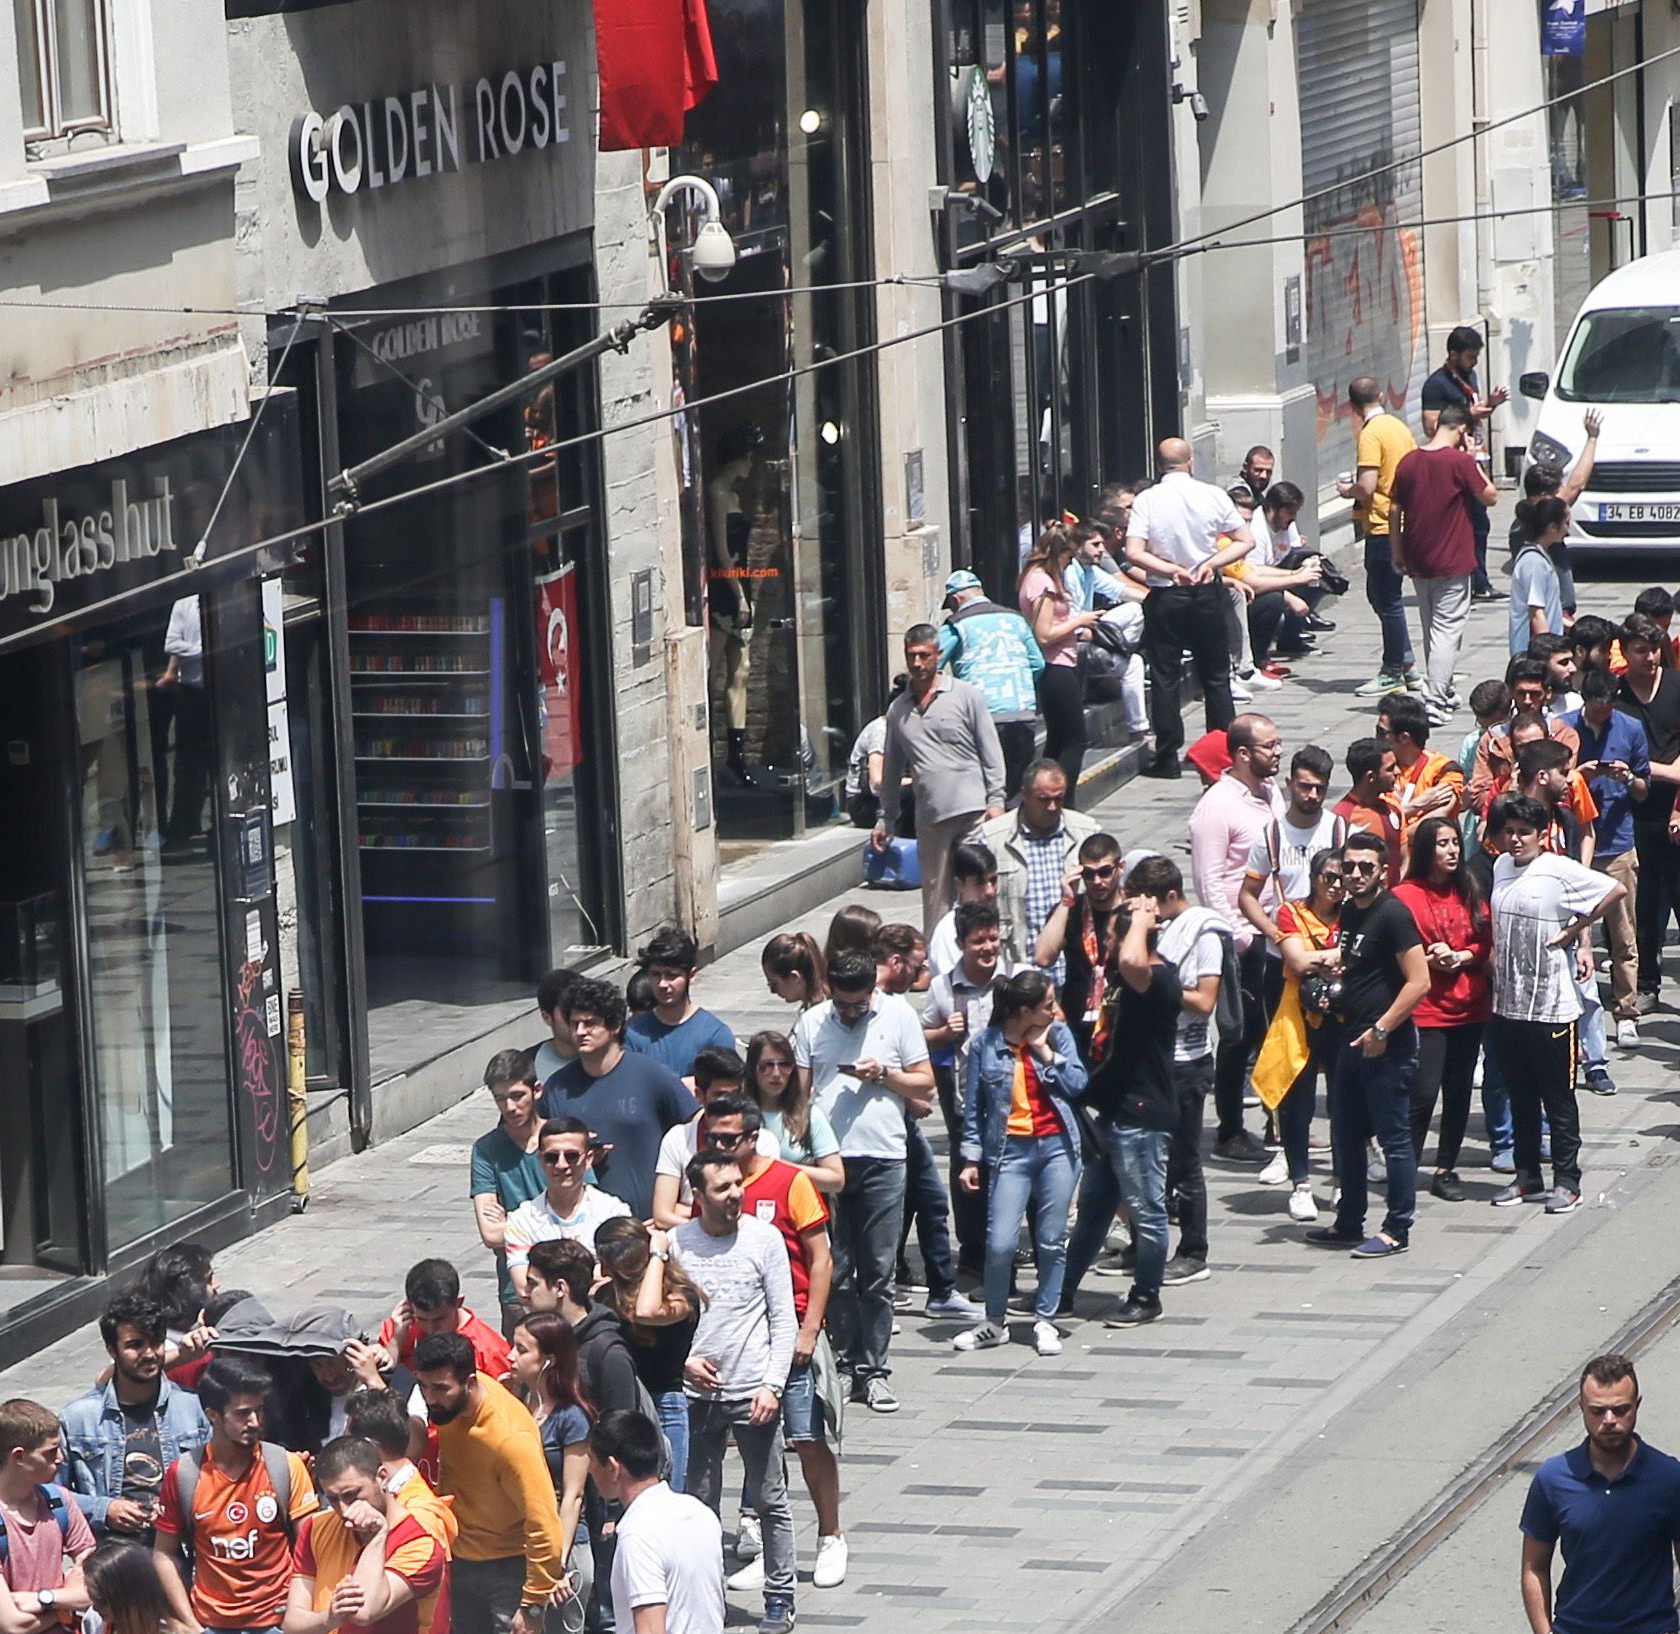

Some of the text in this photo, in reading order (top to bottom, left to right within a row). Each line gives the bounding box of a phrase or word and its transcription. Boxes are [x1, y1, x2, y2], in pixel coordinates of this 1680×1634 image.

[297, 60, 569, 202] GOLDEN ROSE
[373, 312, 481, 363] GOLDEN ROSE
[112, 475, 177, 562] hut
[1608, 505, 1680, 519] 34 EB 4082
[211, 1529, 258, 1560] nef
